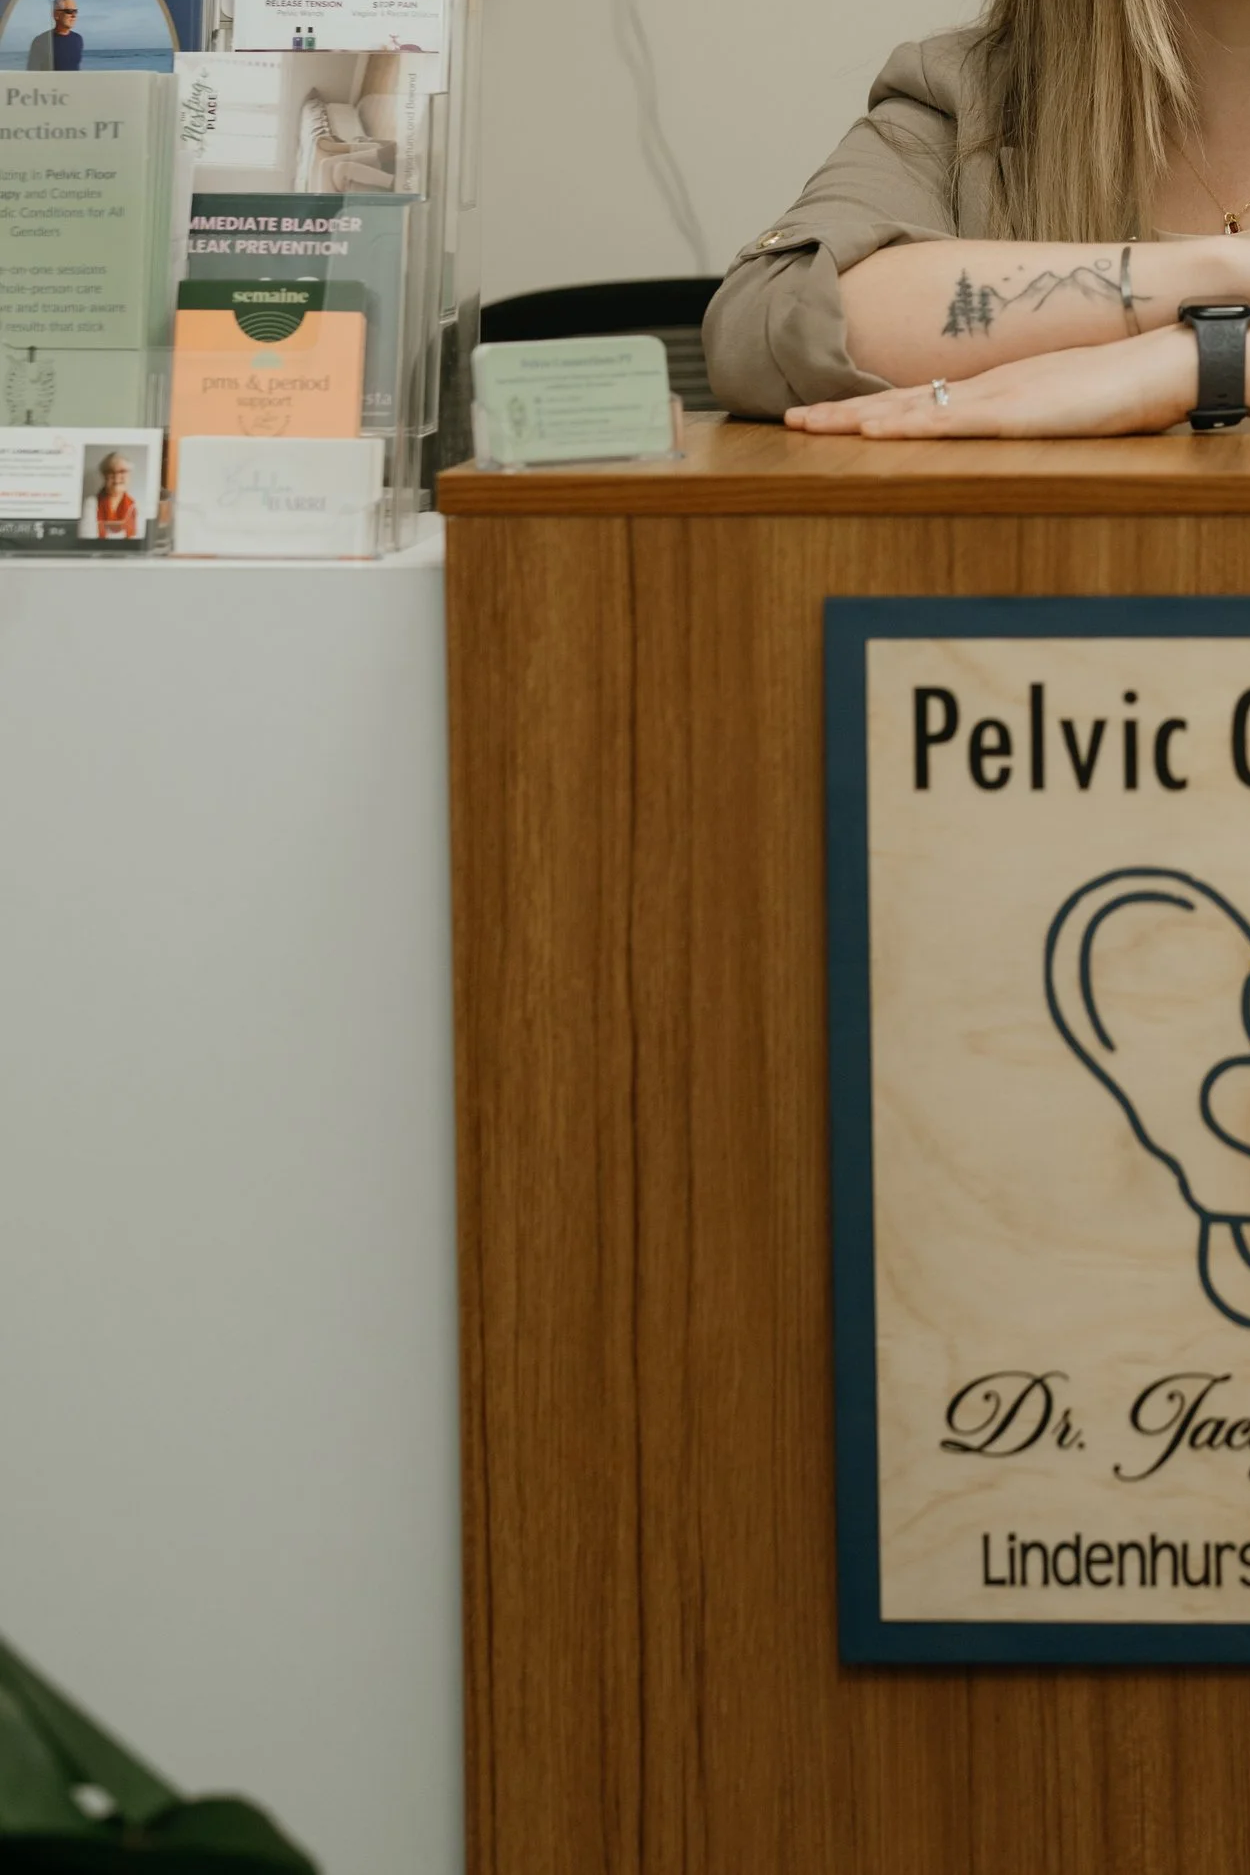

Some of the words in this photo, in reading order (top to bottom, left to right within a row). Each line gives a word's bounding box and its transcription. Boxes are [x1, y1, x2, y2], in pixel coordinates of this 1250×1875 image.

[265, 0, 302, 8] RELEASE
[305, 0, 343, 9] TENSION
[372, 0, 396, 9] STOP
[397, 0, 418, 9] PAIN
[6, 87, 70, 107] Pelvic
[206, 93, 218, 131] PLACE
[94, 120, 125, 140] PT
[45, 168, 81, 180] Pelvic
[85, 168, 117, 180] Floor
[24, 187, 47, 200] and
[19, 206, 86, 219] Conditions
[10, 226, 61, 238] Genders
[189, 215, 278, 232] MMEDIATE
[280, 216, 363, 234] BLADDER
[188, 238, 231, 254] LEAK
[234, 239, 349, 256] PREVENTION
[232, 287, 310, 304] semaine
[202, 375, 240, 394] pms
[245, 374, 265, 393] &
[267, 373, 331, 395] period
[236, 394, 294, 410] support
[913, 681, 1189, 793] Pelvic
[938, 1370, 1086, 1459] Dr.
